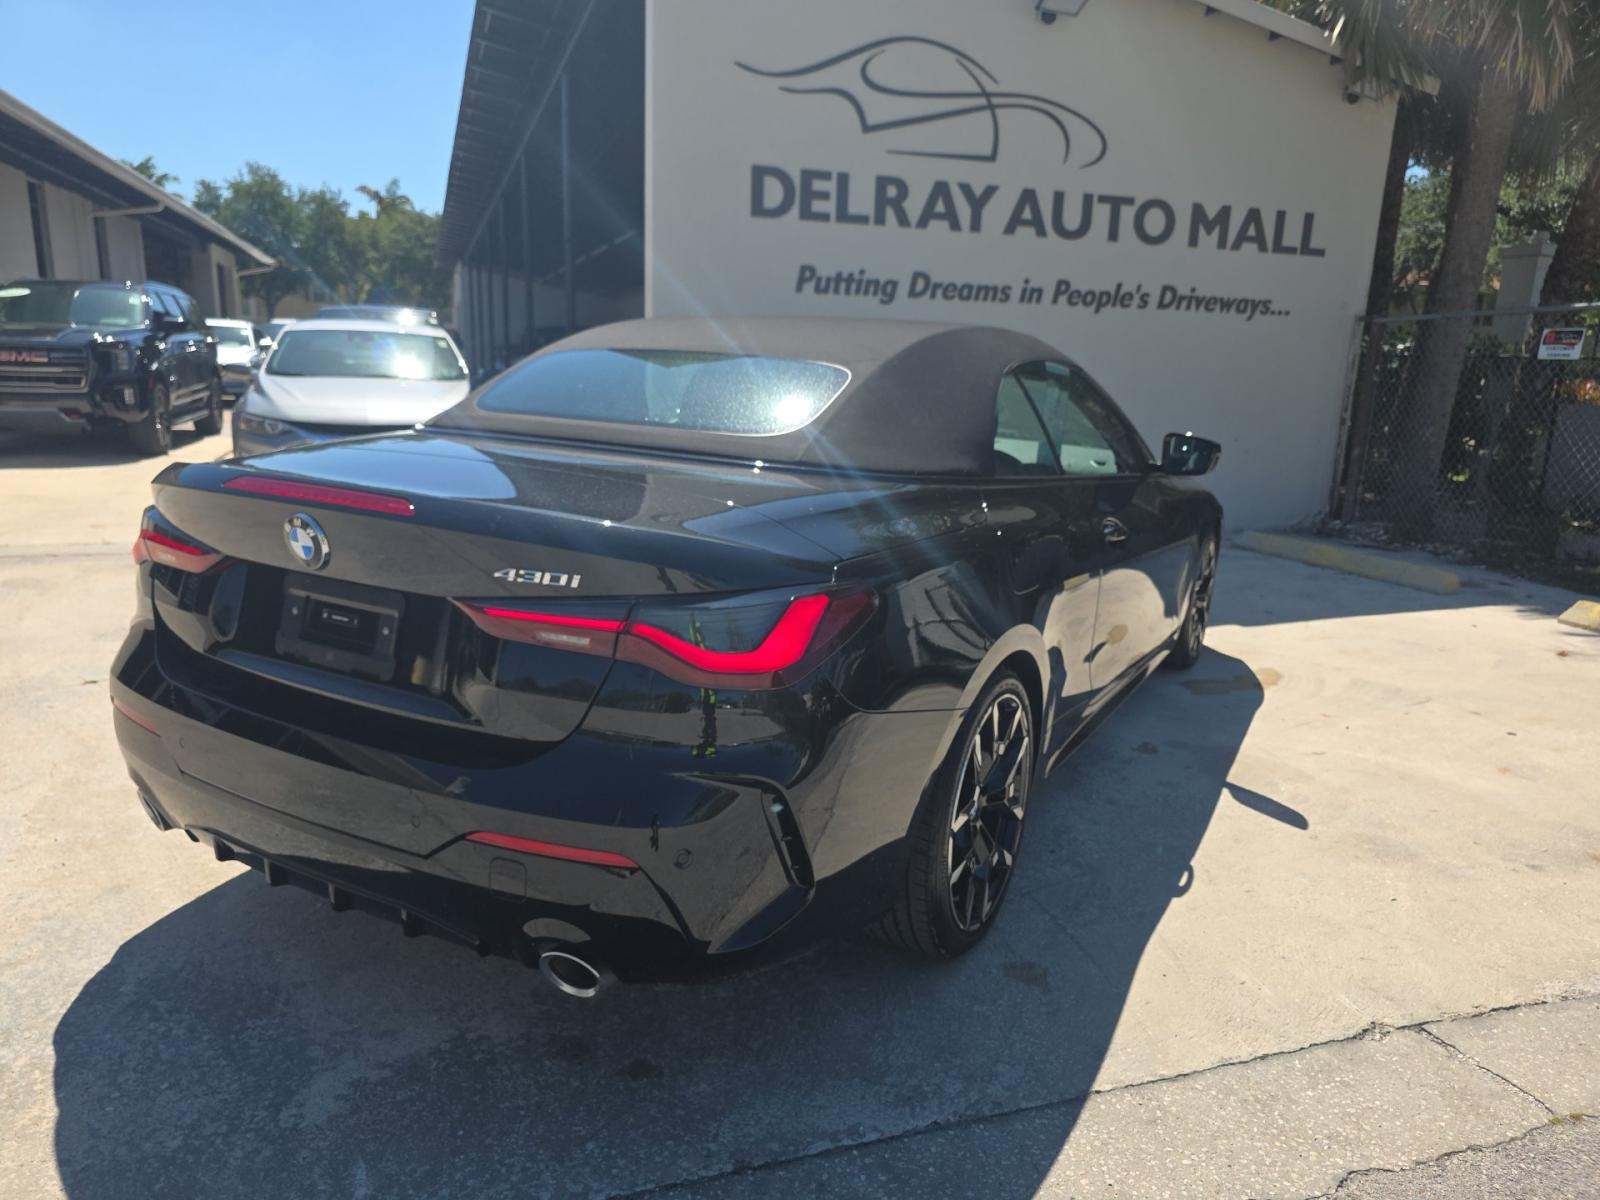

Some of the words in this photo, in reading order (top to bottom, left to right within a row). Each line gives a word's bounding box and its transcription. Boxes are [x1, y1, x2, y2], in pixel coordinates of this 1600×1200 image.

[750, 164, 999, 234] DELRAY
[1003, 188, 1176, 246] AUTO
[1188, 202, 1326, 258] MALL
[796, 264, 899, 306] Putting
[907, 271, 1013, 304] Dreams
[1019, 278, 1044, 305] in
[1051, 279, 1151, 315] People's
[1156, 285, 1291, 322] Driveways...
